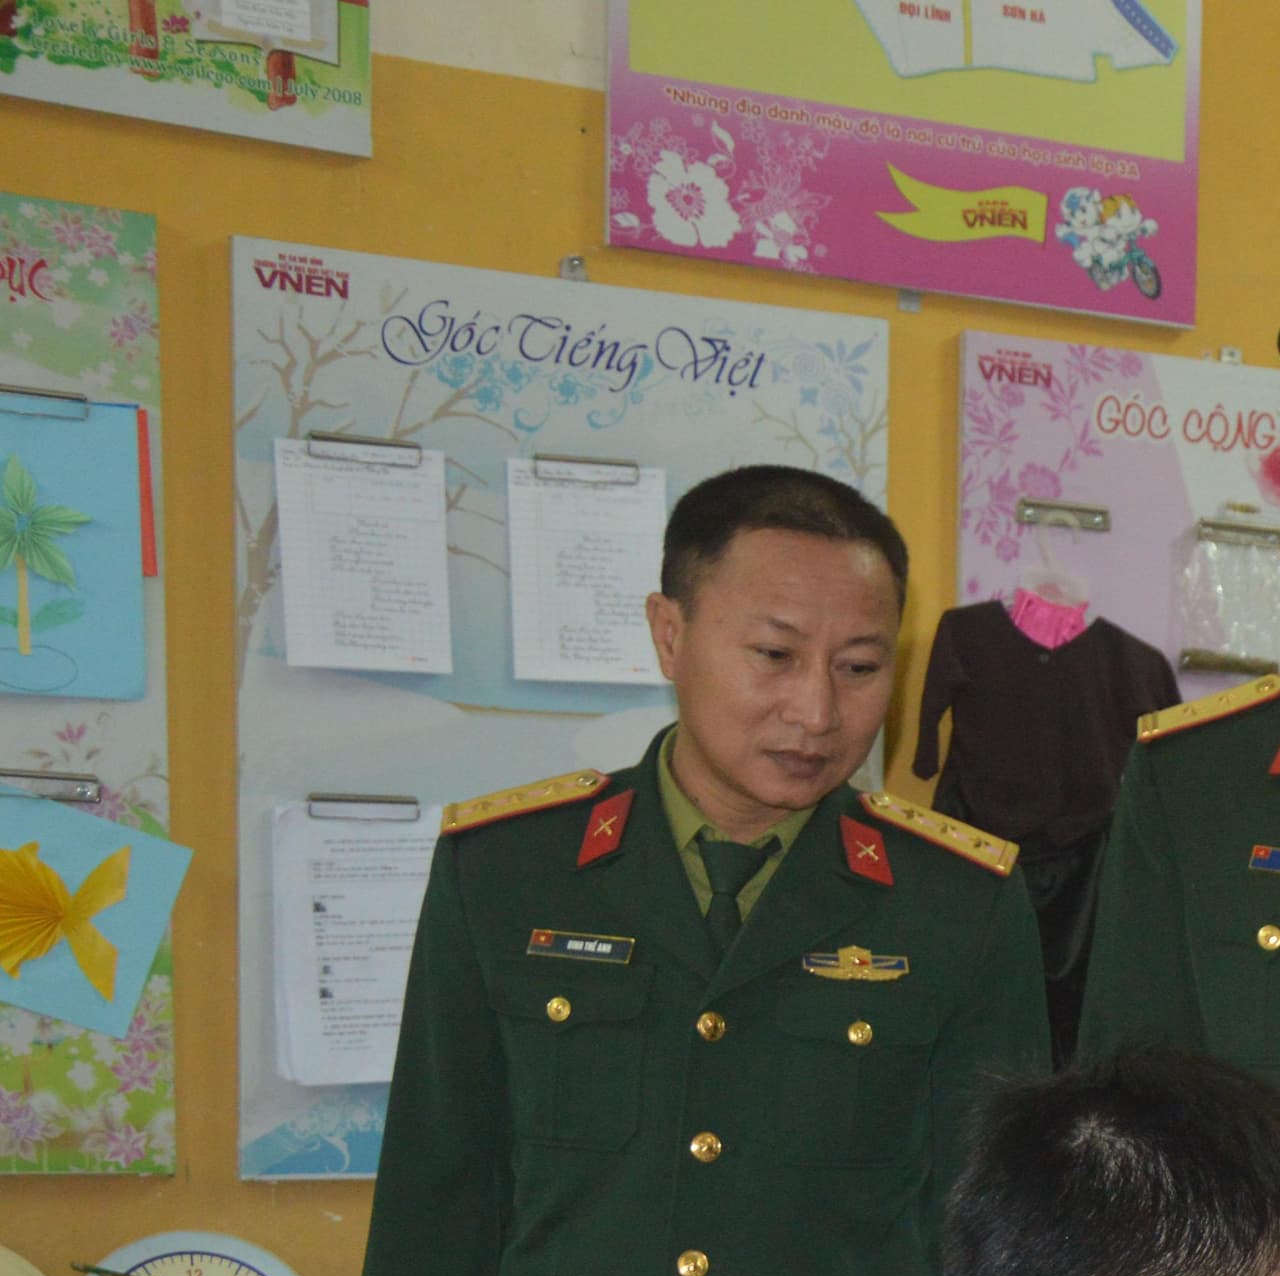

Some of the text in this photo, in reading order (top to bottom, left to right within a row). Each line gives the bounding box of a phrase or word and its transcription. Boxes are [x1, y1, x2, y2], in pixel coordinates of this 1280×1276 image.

[107, 25, 158, 48] Girls
[287, 77, 320, 100] July
[322, 86, 363, 106] 2008
[767, 105, 811, 122] danh
[963, 209, 1028, 231] VNEN
[254, 265, 349, 300] VNEN
[381, 299, 767, 397] Góc Tiếng Việt
[977, 360, 1053, 389] VNEN
[1096, 393, 1170, 440] GÓC
[1182, 402, 1276, 453] CỘNG
